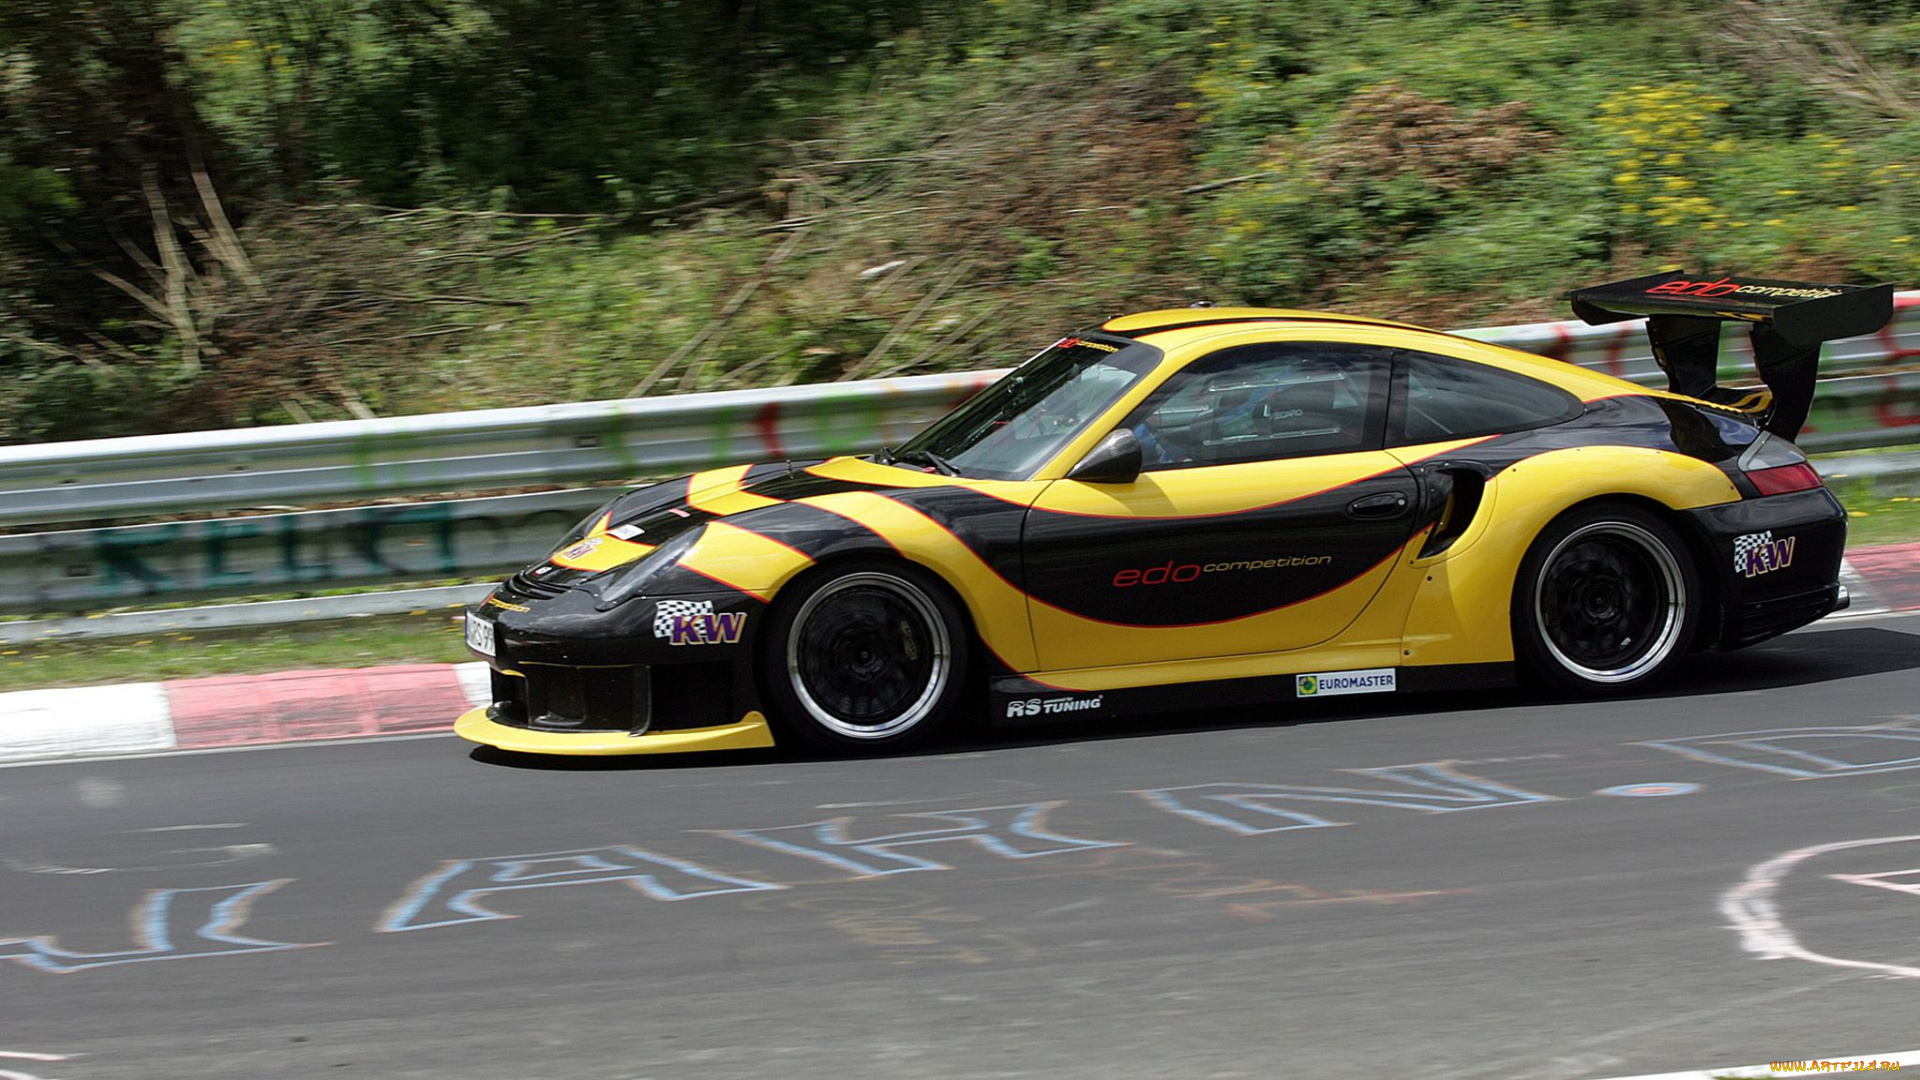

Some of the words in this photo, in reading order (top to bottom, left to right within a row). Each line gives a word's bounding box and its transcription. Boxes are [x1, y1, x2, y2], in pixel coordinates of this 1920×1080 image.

[1646, 277, 1740, 297] edo
[1735, 284, 1843, 299] competiti
[1745, 536, 1795, 578] KW
[1112, 560, 1201, 588] edo
[1203, 555, 1333, 572] competition
[669, 612, 747, 646] KW
[1319, 675, 1394, 690] EUROMASTER
[1006, 698, 1041, 718] RS
[1043, 698, 1102, 714] TUNING
